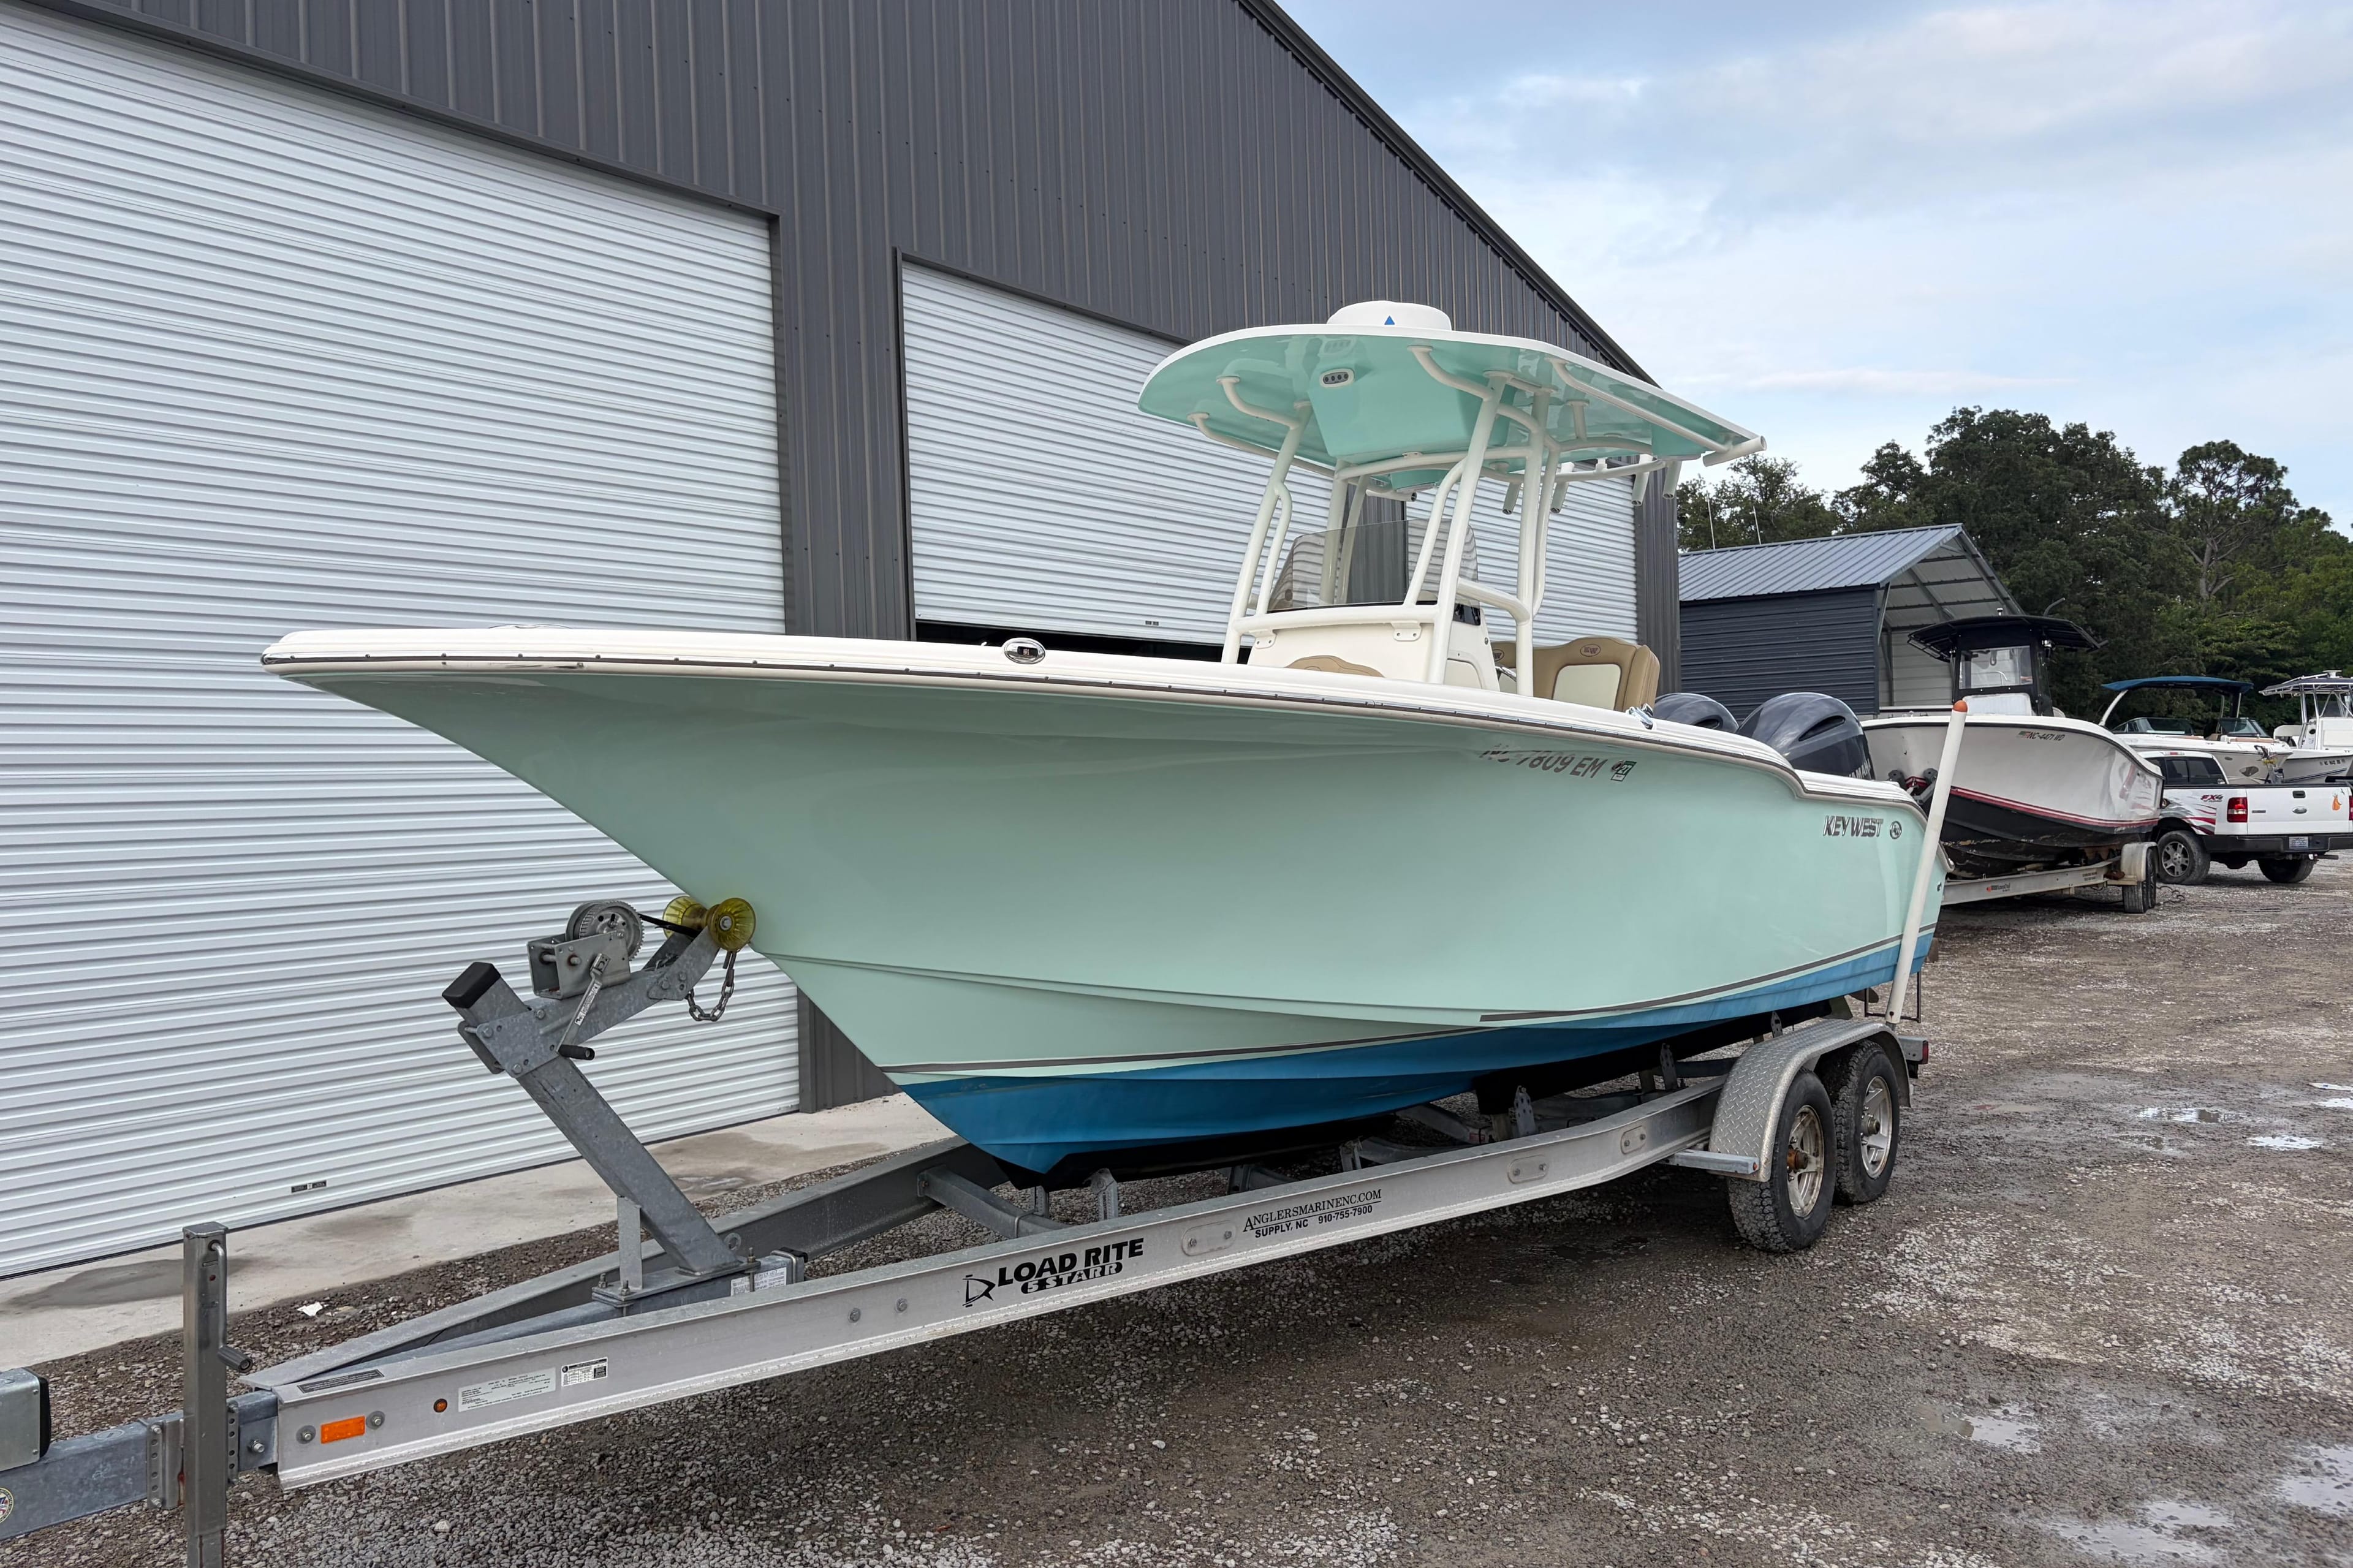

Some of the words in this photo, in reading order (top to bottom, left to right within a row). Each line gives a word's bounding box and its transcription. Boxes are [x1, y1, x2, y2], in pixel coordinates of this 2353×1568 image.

[1569, 757, 1608, 778] EM
[1243, 1189, 1382, 1232] ANGLERSMARINENC.COM
[1255, 1222, 1294, 1238] SUPPLY,
[1295, 1219, 1309, 1229] NC
[1318, 1205, 1373, 1224] 910-755-7900
[998, 1252, 1077, 1287] LOAD
[1084, 1238, 1144, 1268] RITE
[1027, 1281, 1039, 1293] 5
[1045, 1263, 1118, 1289] STARR
